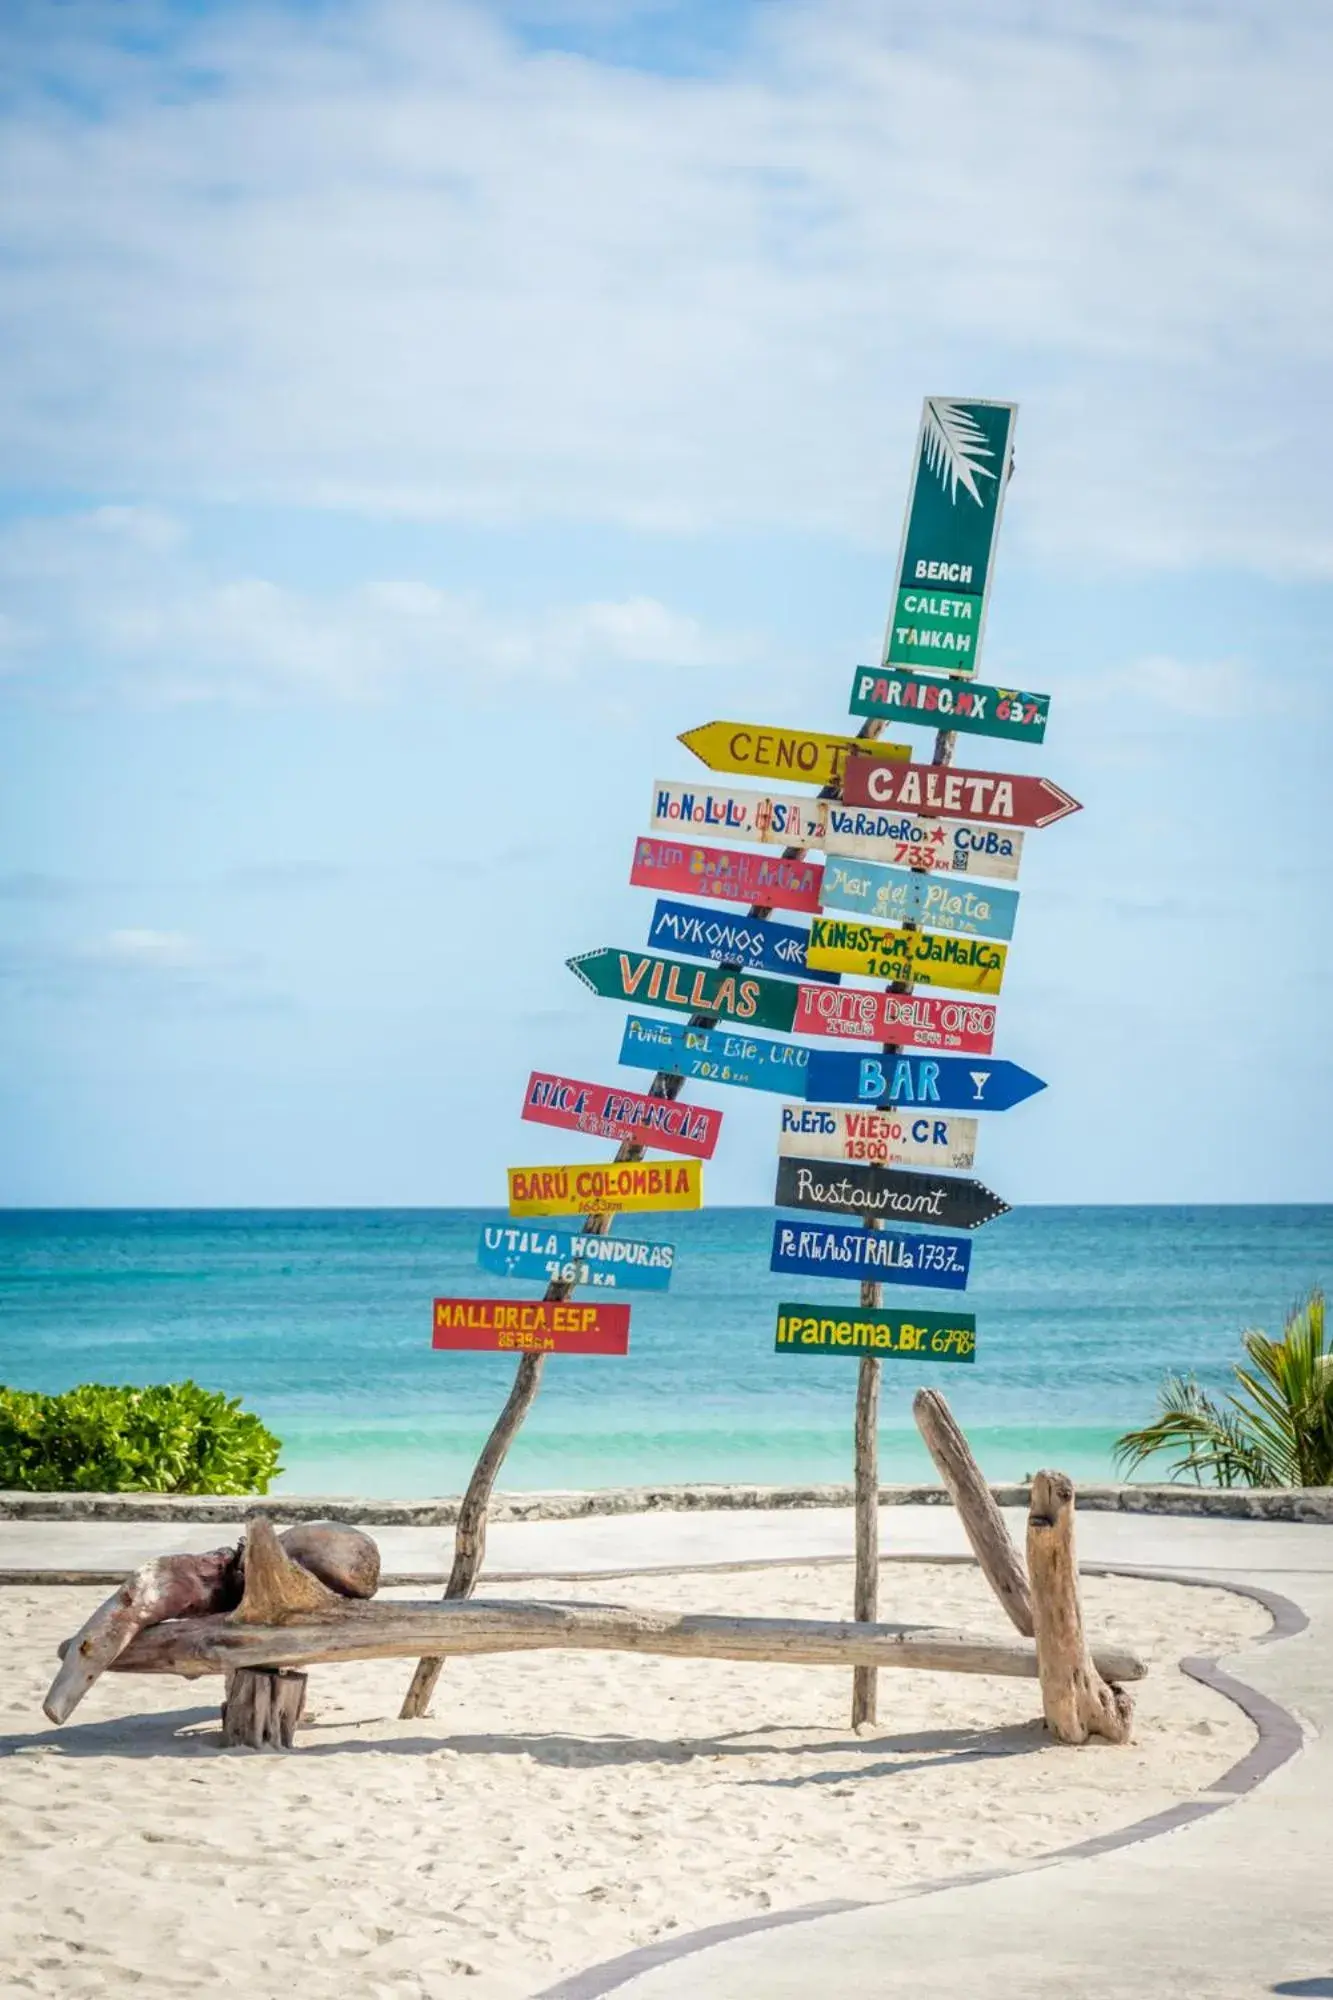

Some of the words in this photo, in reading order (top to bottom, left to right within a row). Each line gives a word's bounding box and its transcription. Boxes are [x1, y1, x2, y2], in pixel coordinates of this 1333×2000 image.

[915, 560, 973, 584] BEACH
[904, 596, 973, 619] CALETA
[896, 628, 971, 652] TANKAH
[729, 732, 872, 776] CENOT
[867, 768, 1014, 817] CALETA
[755, 800, 801, 836] USA
[825, 868, 872, 897] Mar
[876, 881, 908, 904] del
[923, 884, 990, 920] Plata
[655, 912, 765, 956] MYKONOS
[774, 937, 808, 964] GRE
[619, 954, 761, 1017] VILLAS
[770, 1045, 810, 1067] URU
[858, 1058, 940, 1101] BAR
[797, 1168, 947, 1215] Restaurant
[570, 1236, 673, 1268] HONDURAS
